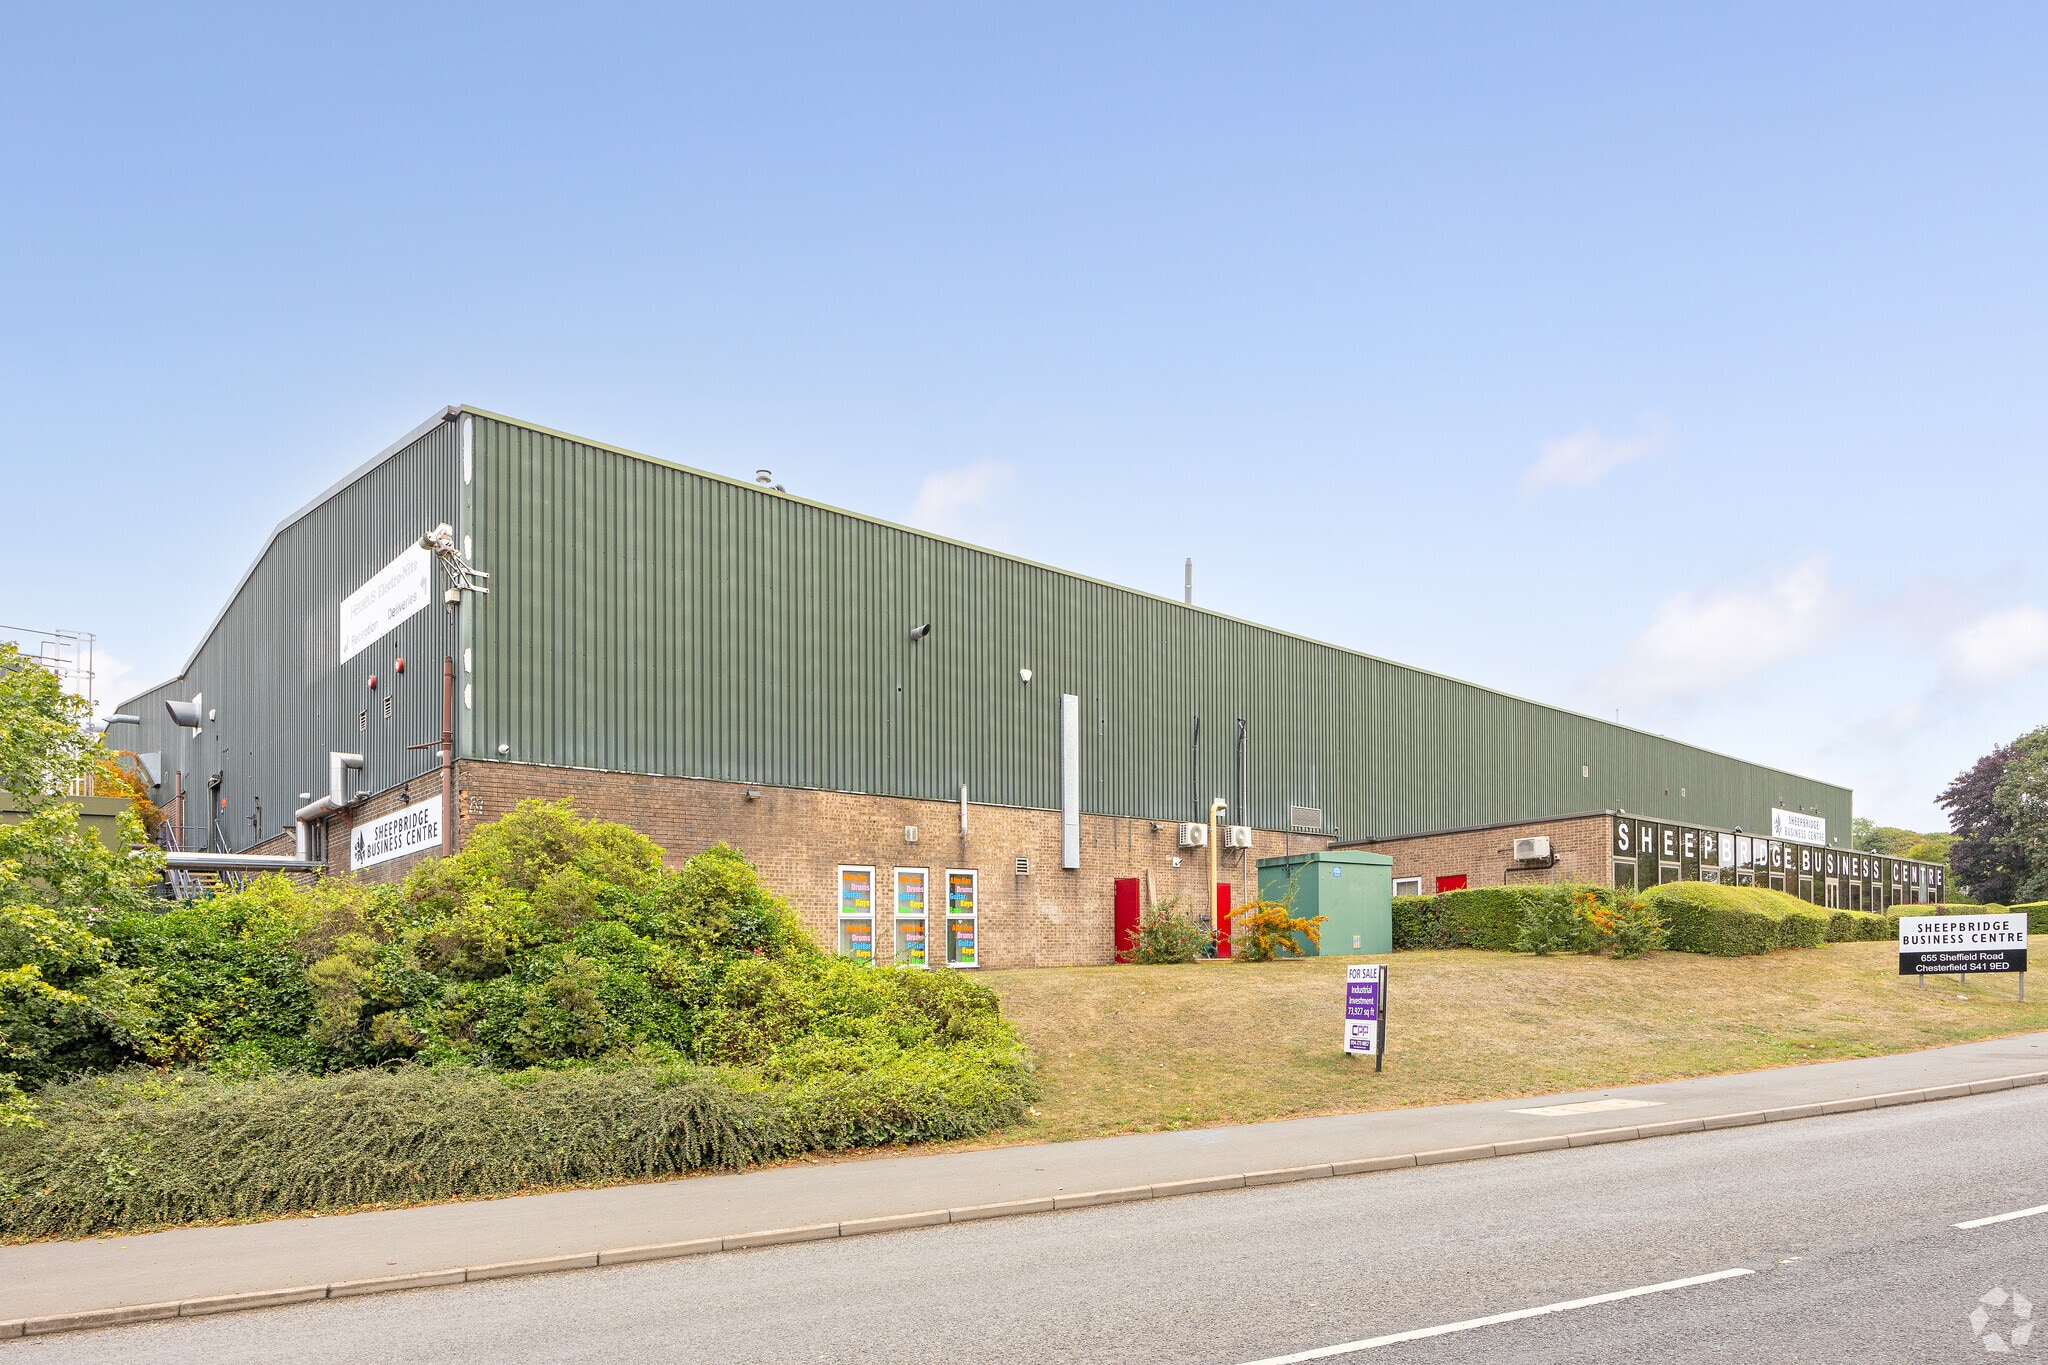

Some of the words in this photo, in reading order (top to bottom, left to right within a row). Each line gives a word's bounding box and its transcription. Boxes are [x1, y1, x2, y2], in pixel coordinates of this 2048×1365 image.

[388, 592, 417, 620] Deliveries
[352, 621, 378, 646] Reception
[375, 808, 428, 840] SHEEPBRIDGE
[1789, 816, 1819, 830] SHEEPBRIDGE
[1785, 827, 1806, 839] BUSINESS
[1808, 831, 1824, 842] CENTRE
[367, 834, 402, 858] BUSINESS
[406, 822, 438, 846] CENTRE
[1618, 823, 1791, 869] SHEEPBRIDGE
[1802, 850, 1880, 879] BUSINESS
[1893, 864, 1942, 886] CENTRE
[851, 883, 870, 891] Drums
[842, 891, 861, 899] Guitar
[898, 893, 915, 901] Guitar
[855, 899, 870, 908] Keys
[910, 900, 923, 909] Keys
[1918, 921, 2009, 933] SHEEPBRIDGE
[852, 934, 870, 942] Drums
[958, 939, 974, 947] Guitar
[1903, 934, 1963, 945] BUSINESS
[1972, 932, 2023, 943] CENTRE
[852, 942, 872, 950] Guitar
[962, 947, 974, 955] Keys
[856, 950, 871, 958] Keys
[1921, 954, 1937, 962] 655
[1940, 953, 1977, 961] Sheffield
[1980, 952, 2004, 960] Road
[1916, 963, 1967, 972] Chesterfield
[1970, 962, 1986, 970] S41
[1989, 962, 2010, 970] 9ED
[1349, 968, 1360, 978] FOR
[1363, 968, 1377, 979] SALE
[1351, 985, 1372, 994] Industrial
[1349, 997, 1374, 1005] Investment
[1348, 1007, 1363, 1016] 73,927
[1364, 1010, 1369, 1018] sq
[1370, 1008, 1374, 1016] ft
